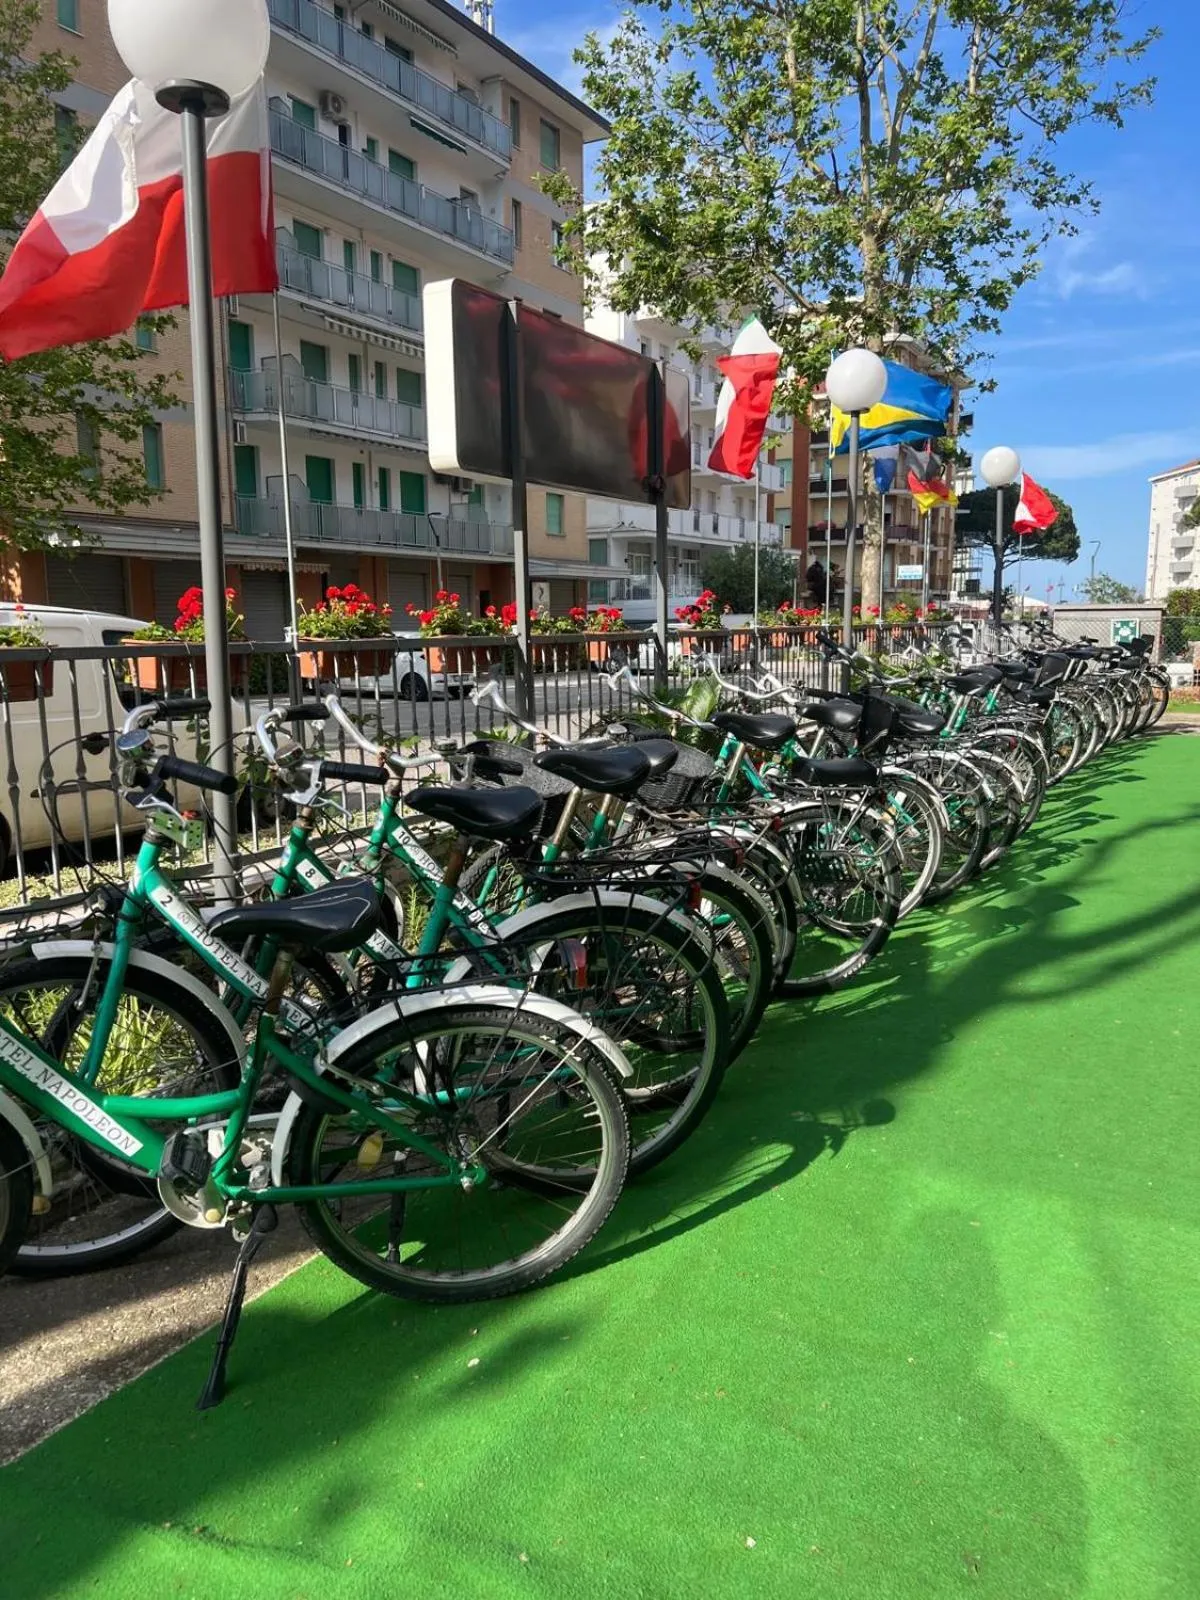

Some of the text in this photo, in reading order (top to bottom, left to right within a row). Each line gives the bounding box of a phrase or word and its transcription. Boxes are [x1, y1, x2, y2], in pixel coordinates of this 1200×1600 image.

[398, 831, 411, 845] 10
[305, 868, 315, 878] 8
[160, 894, 173, 907] 2
[192, 924, 240, 973] HOTEL
[0, 1033, 136, 1150] TEL NAPOLEON
